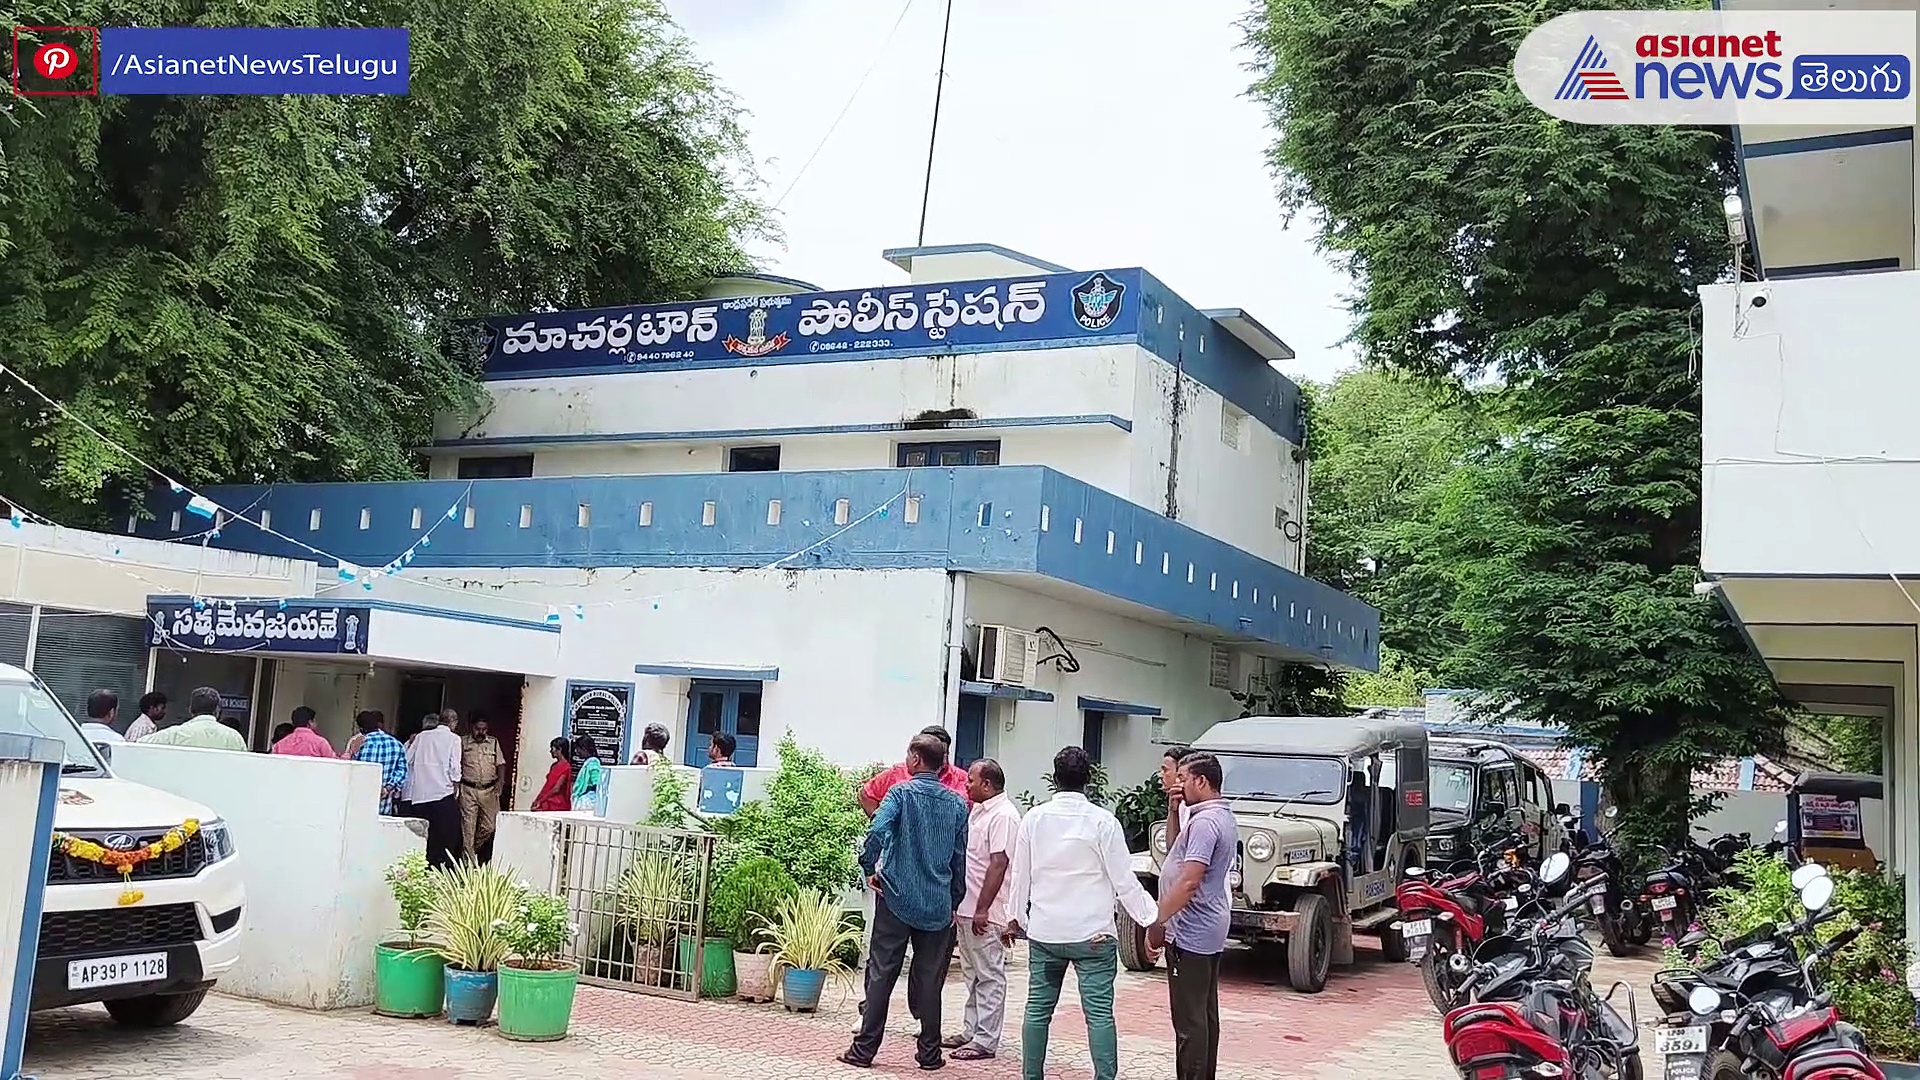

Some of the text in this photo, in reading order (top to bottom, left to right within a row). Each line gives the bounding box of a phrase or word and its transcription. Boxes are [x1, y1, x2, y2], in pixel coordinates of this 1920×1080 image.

[1079, 313, 1111, 328] POLICE
[81, 963, 117, 983] AP39
[120, 962, 128, 978] P
[133, 958, 164, 976] 1128
